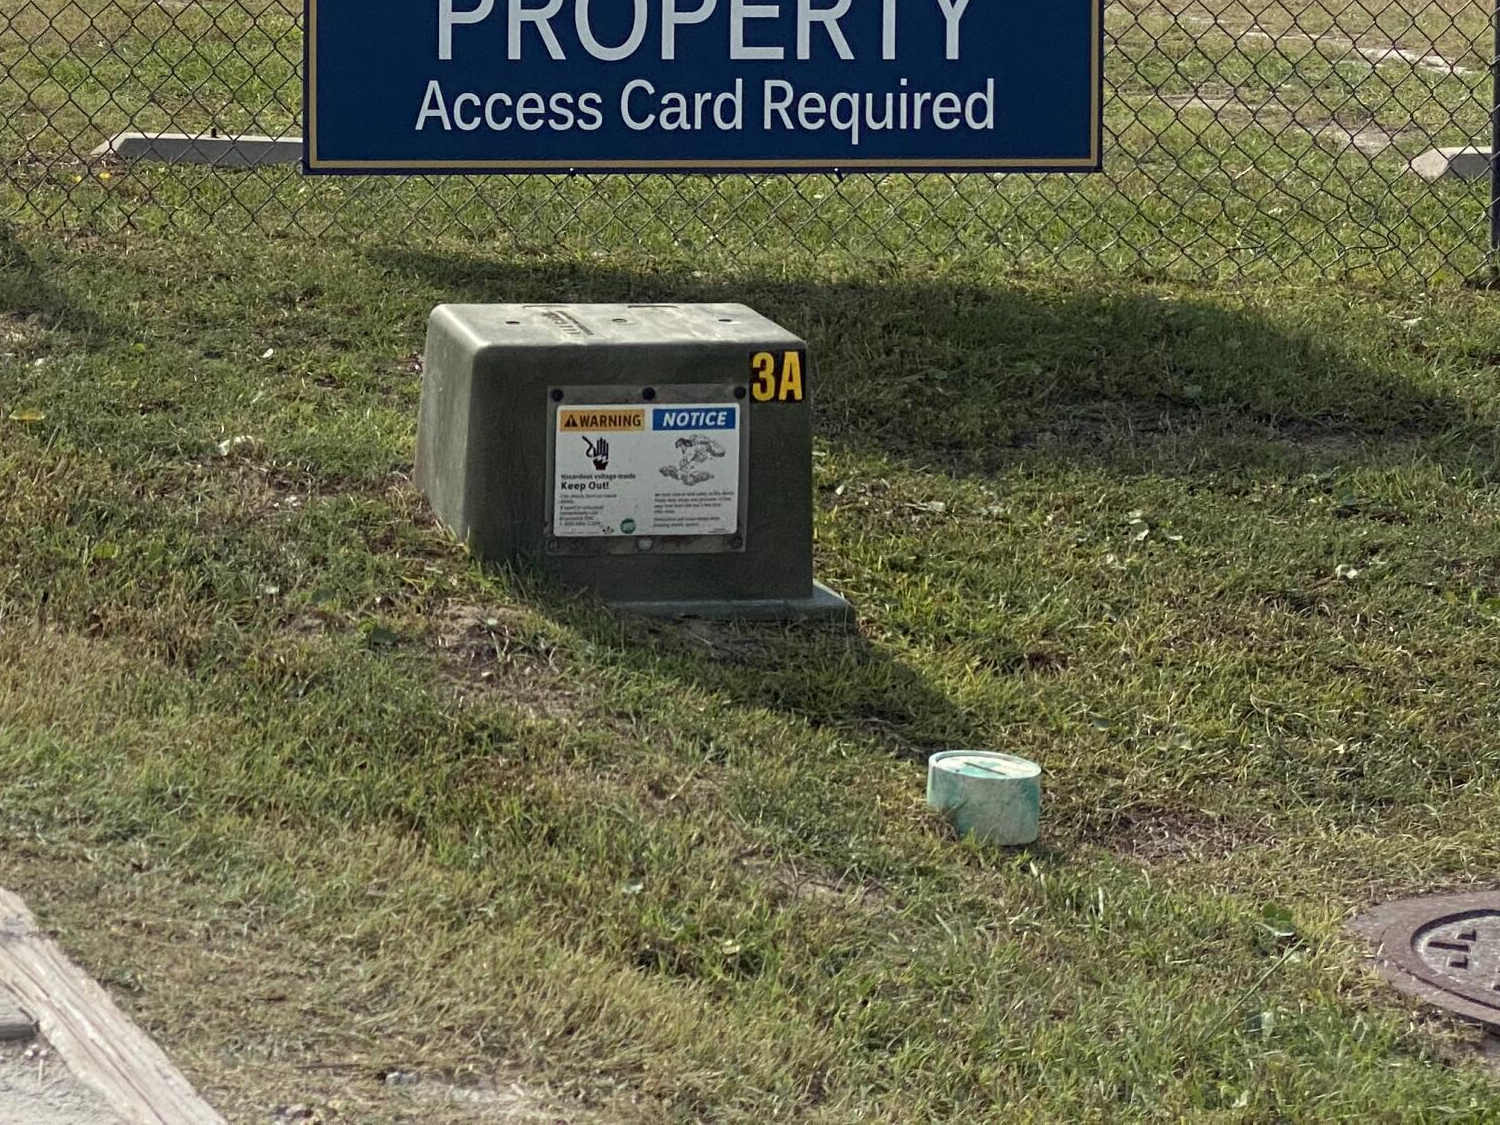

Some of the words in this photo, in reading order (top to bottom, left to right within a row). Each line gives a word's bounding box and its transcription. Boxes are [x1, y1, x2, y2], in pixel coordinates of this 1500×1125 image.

[415, 79, 603, 132] Access
[620, 78, 743, 132] Card
[764, 78, 994, 145] Required
[752, 350, 803, 401] 3A
[580, 414, 641, 427] WARNING
[663, 411, 728, 427] NOTICE
[561, 482, 586, 491] Keep
[588, 481, 610, 490] Out!
